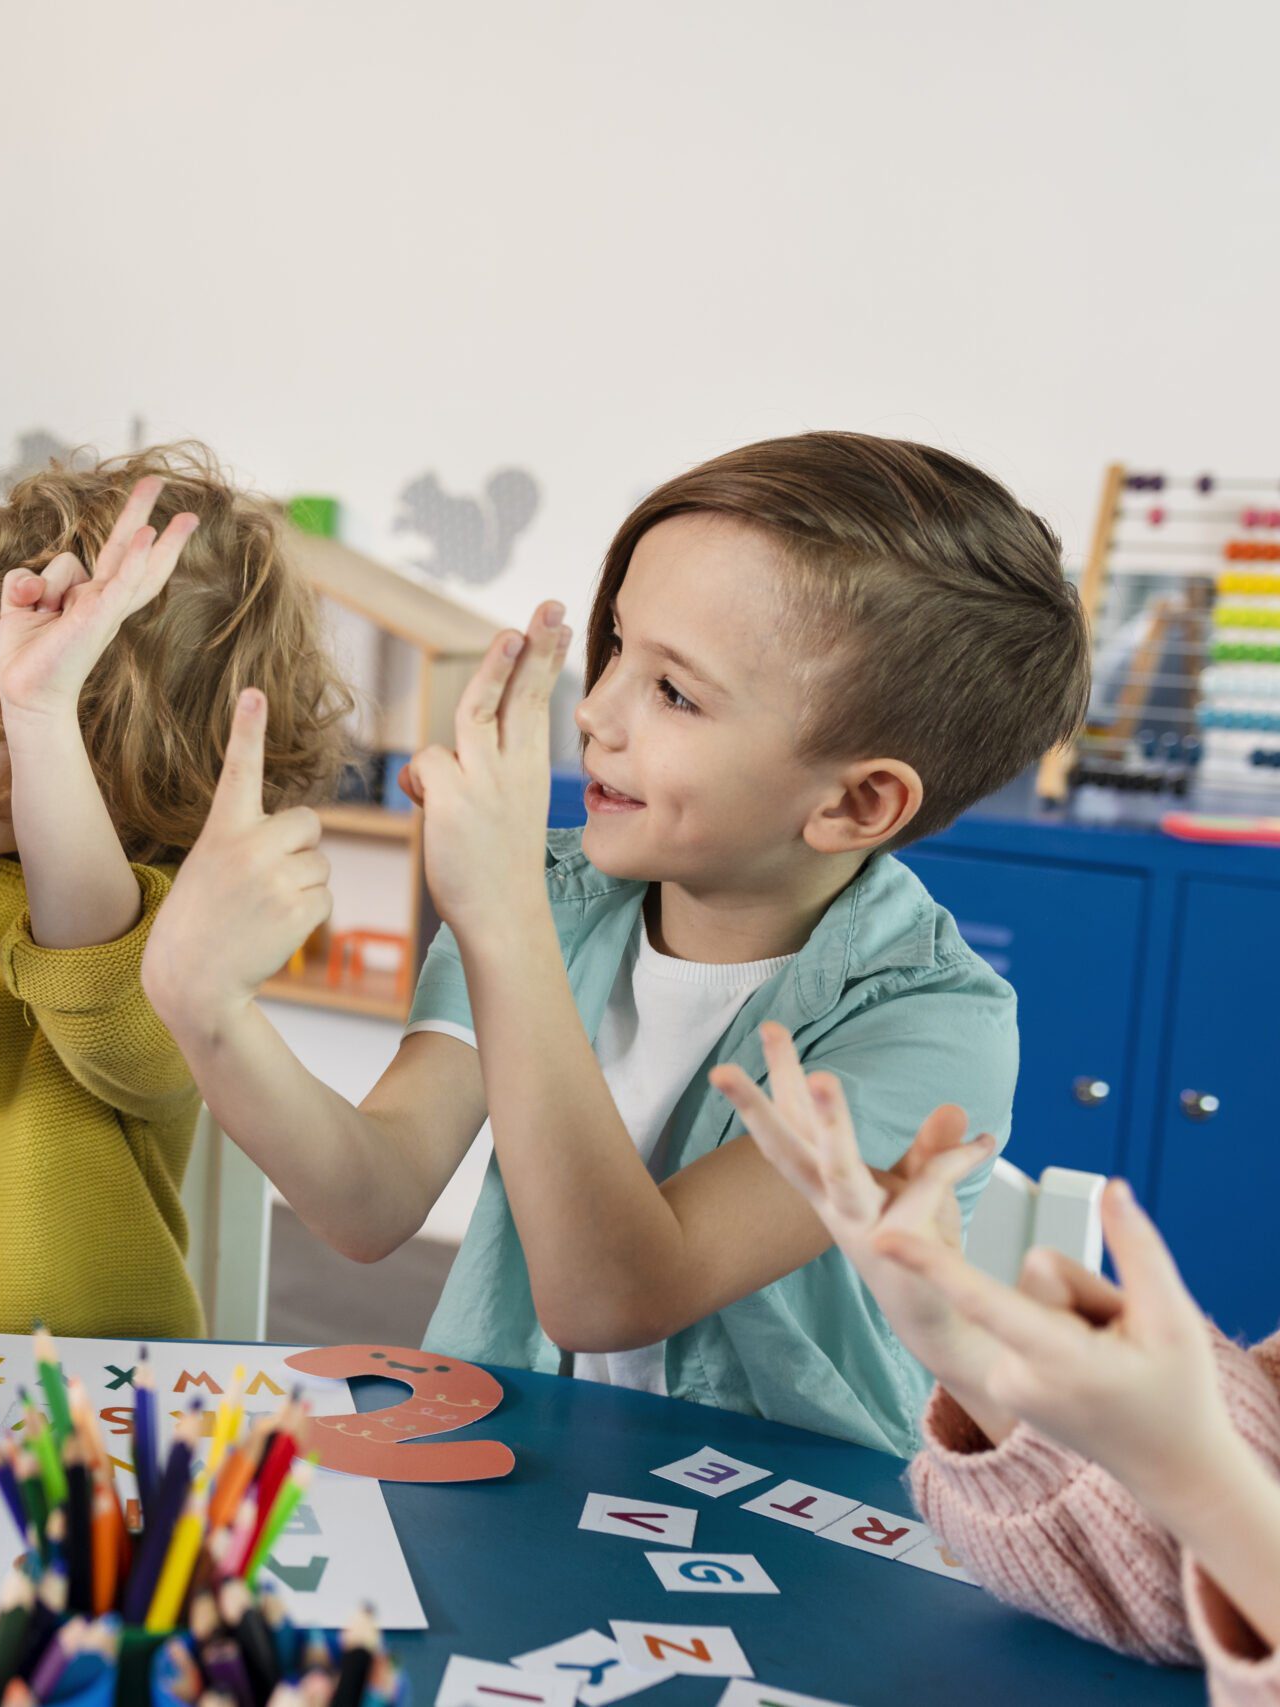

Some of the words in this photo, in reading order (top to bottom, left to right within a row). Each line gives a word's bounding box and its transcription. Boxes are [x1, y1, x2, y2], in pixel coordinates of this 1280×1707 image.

[103, 1364, 138, 1391] X
[245, 1370, 287, 1396] V
[99, 1406, 138, 1435] S
[683, 1461, 740, 1485] E
[769, 1495, 818, 1519] T
[606, 1512, 669, 1534] V
[851, 1516, 910, 1546] R
[678, 1560, 745, 1584] G
[555, 1658, 620, 1686] Y
